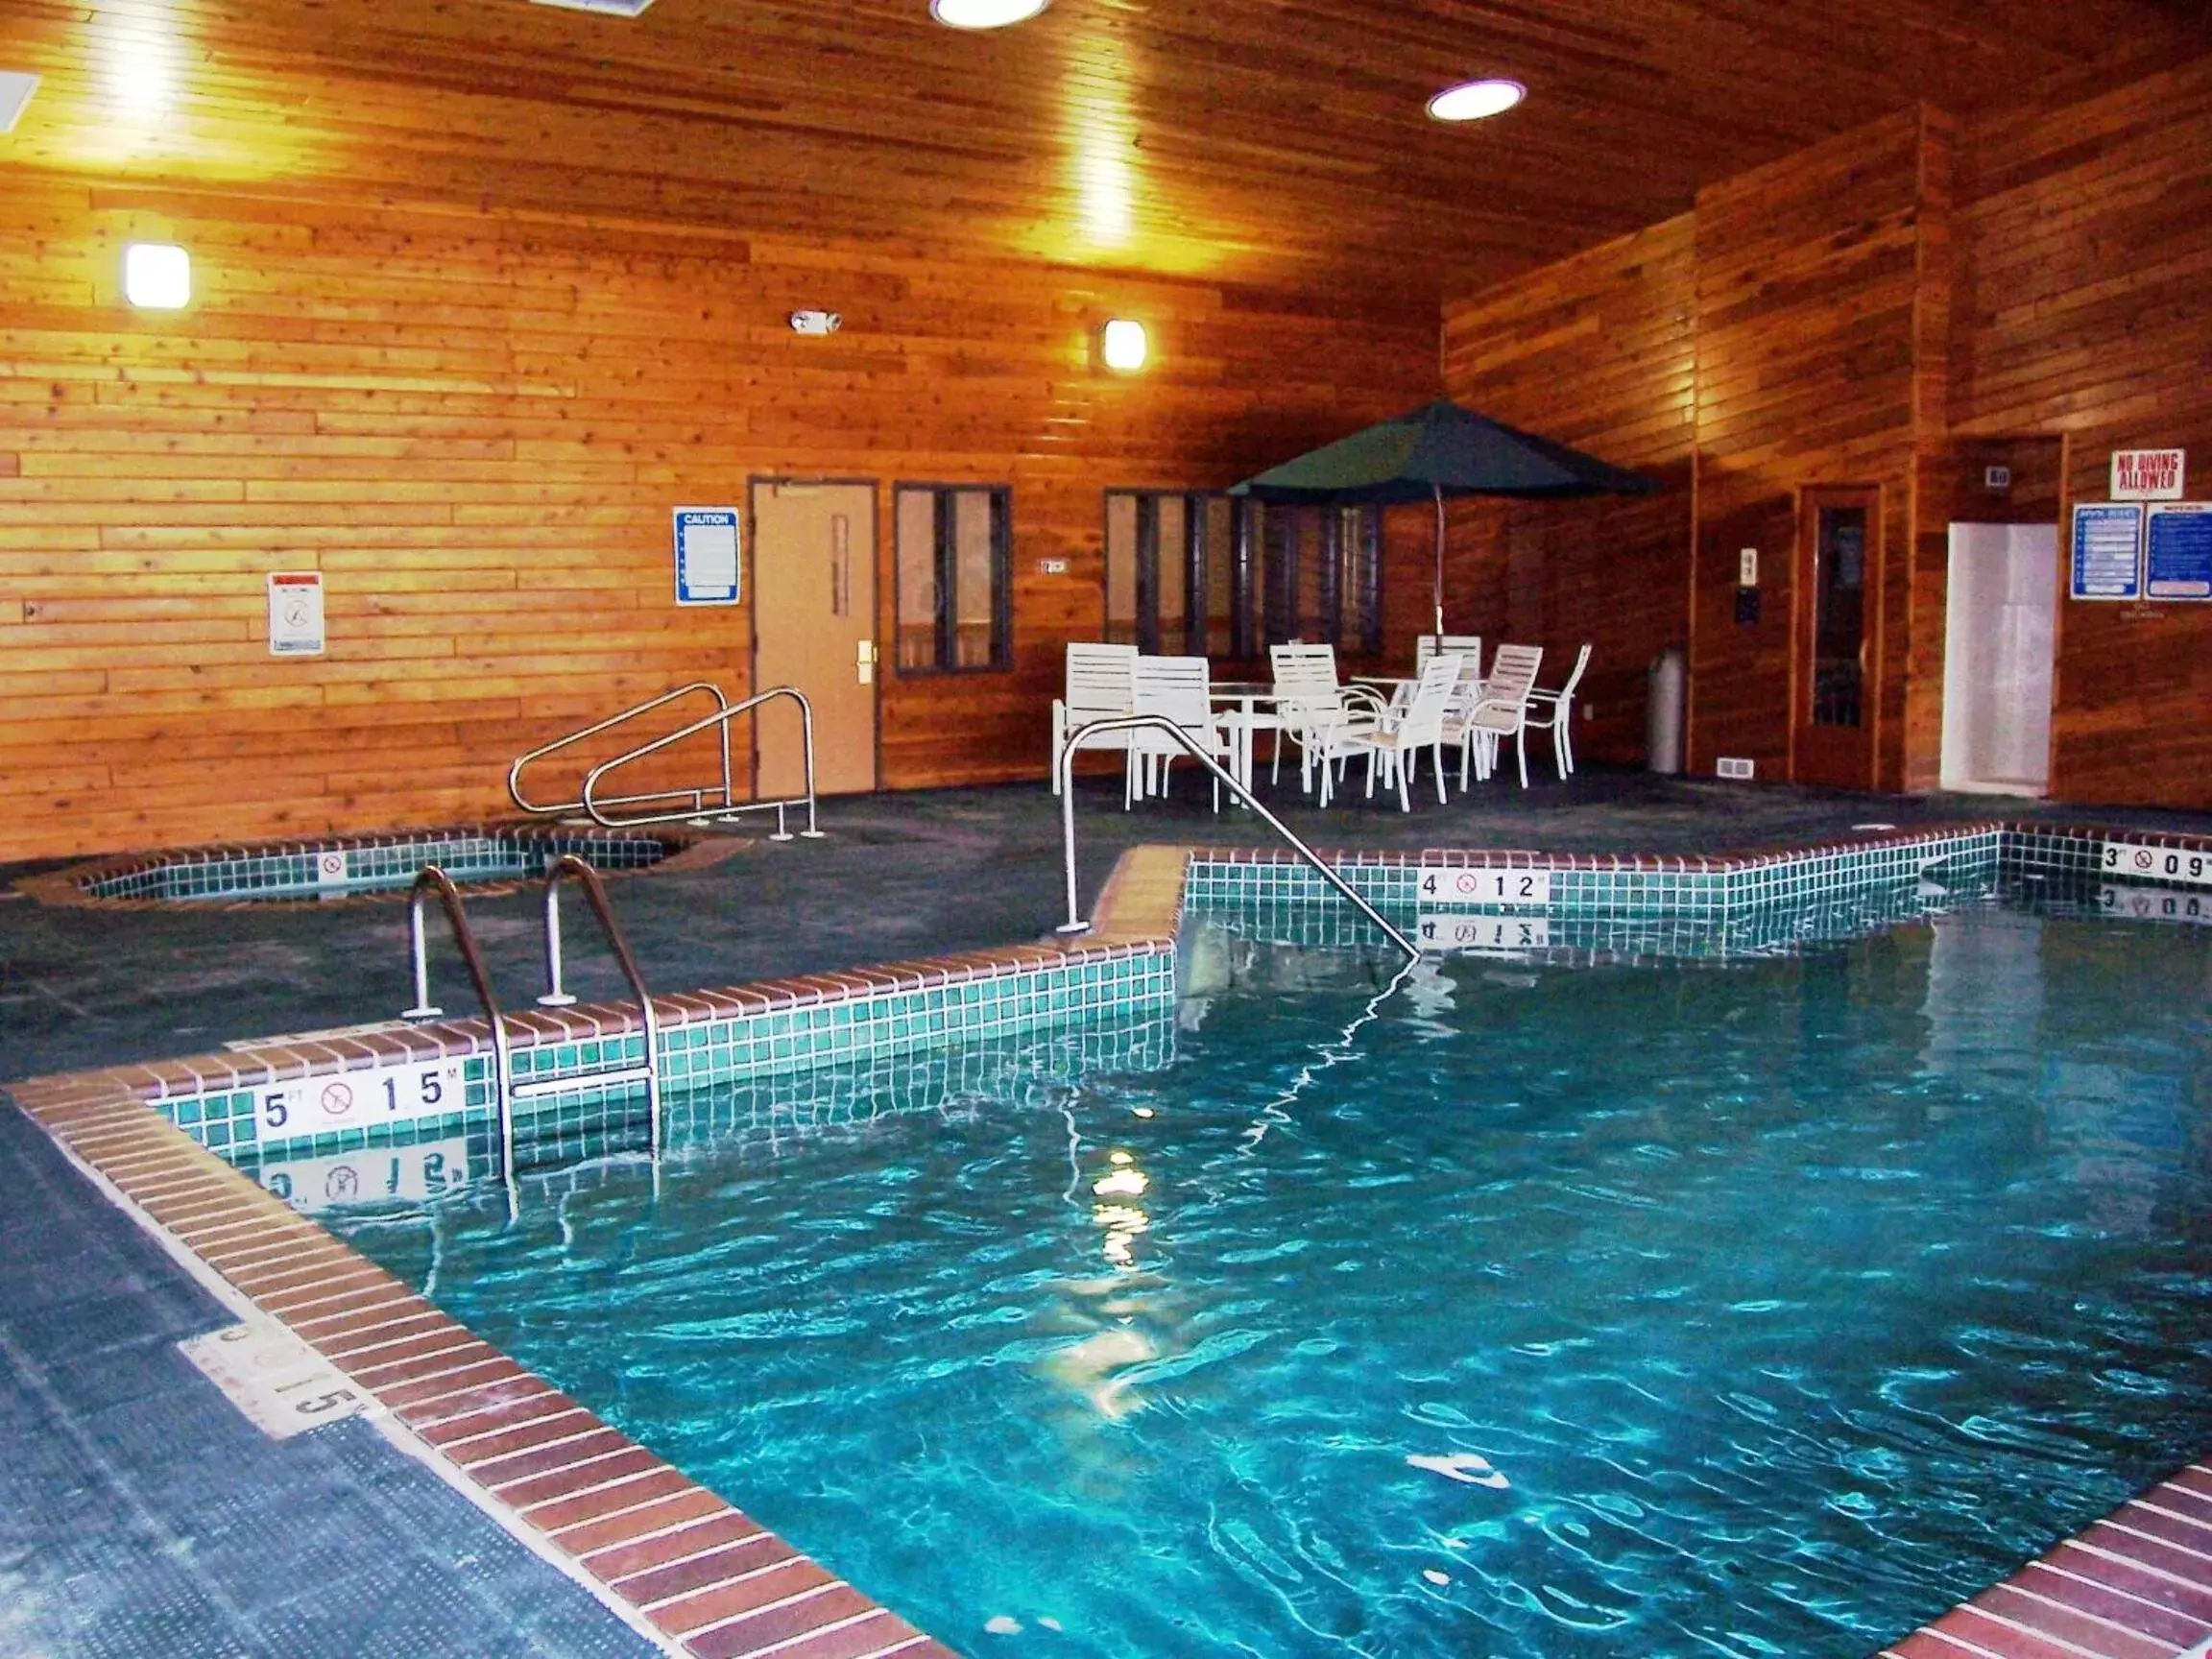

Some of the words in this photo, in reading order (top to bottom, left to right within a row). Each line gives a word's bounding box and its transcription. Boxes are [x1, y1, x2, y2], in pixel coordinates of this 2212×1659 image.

[2117, 453, 2133, 472] NO
[2137, 451, 2178, 471] DIVING
[2119, 470, 2176, 491] ALLOWED
[684, 514, 730, 525] CAUTION
[2104, 847, 2118, 867] 3
[1422, 874, 1437, 896] 4
[264, 1093, 288, 1128] 5
